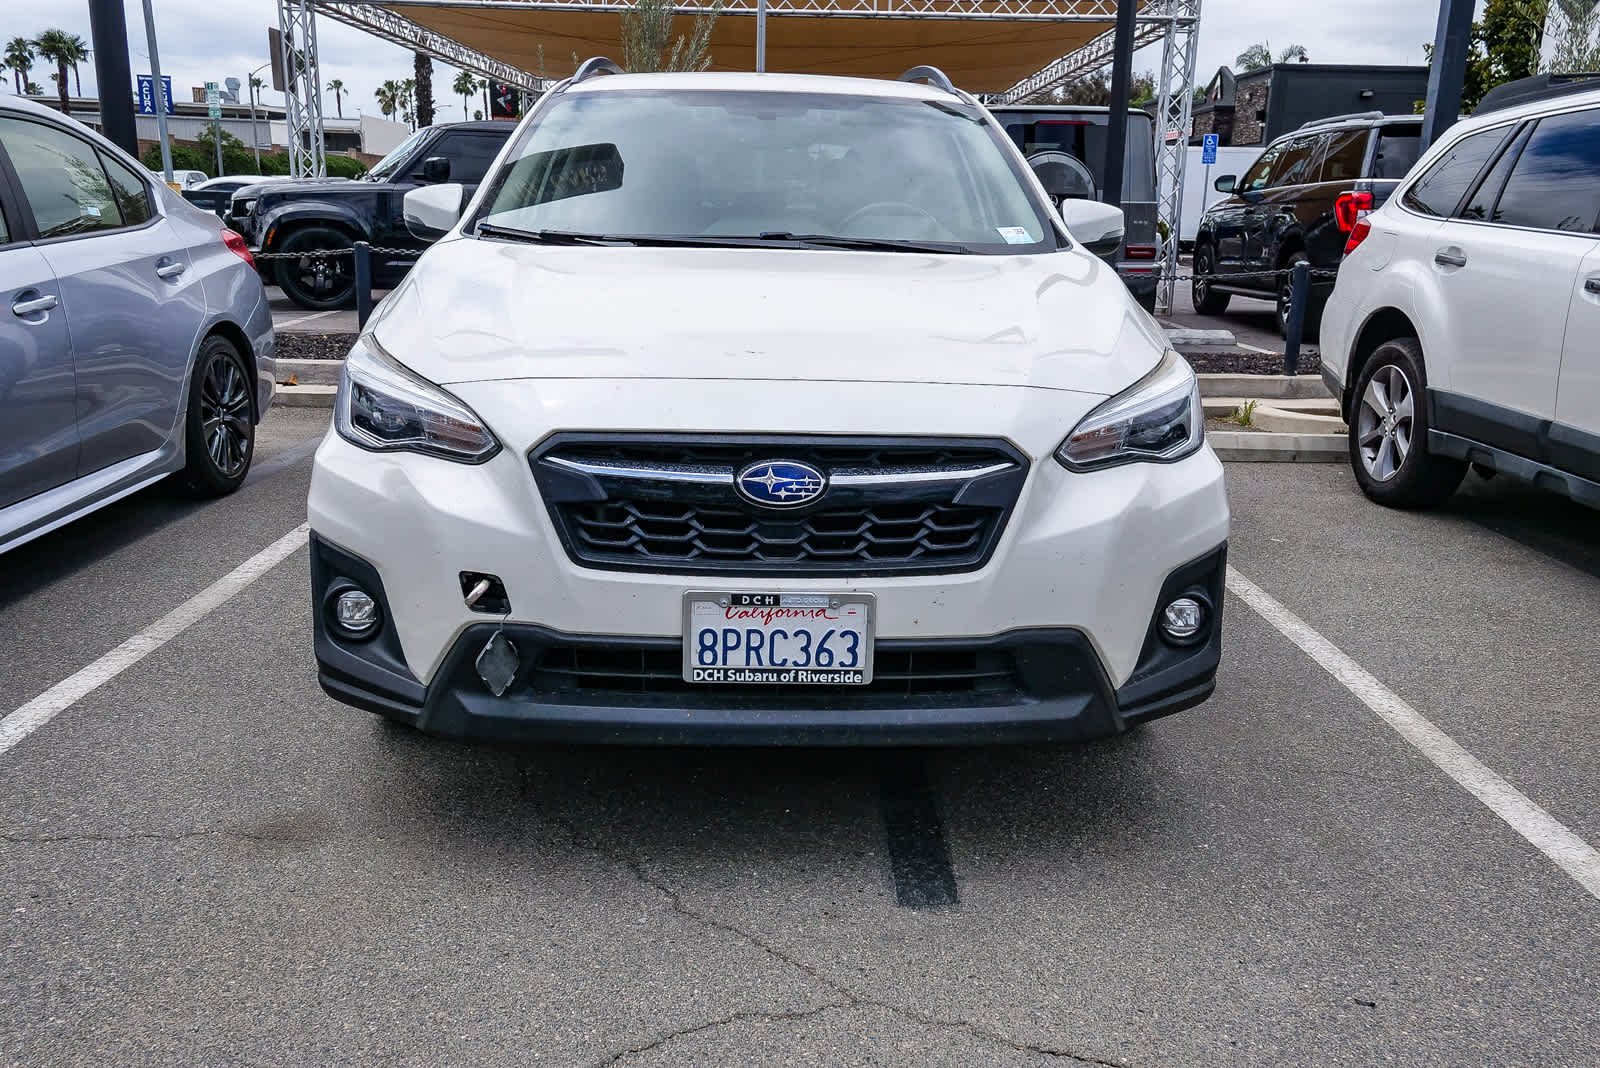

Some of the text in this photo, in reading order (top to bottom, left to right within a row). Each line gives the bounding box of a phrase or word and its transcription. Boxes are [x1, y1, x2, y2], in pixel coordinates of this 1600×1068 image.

[142, 80, 153, 113] ACURA
[741, 595, 775, 606] DCH
[725, 606, 839, 626] California
[698, 628, 860, 668] 8PRC363
[693, 669, 863, 684] DCH Subaru of Riverside
